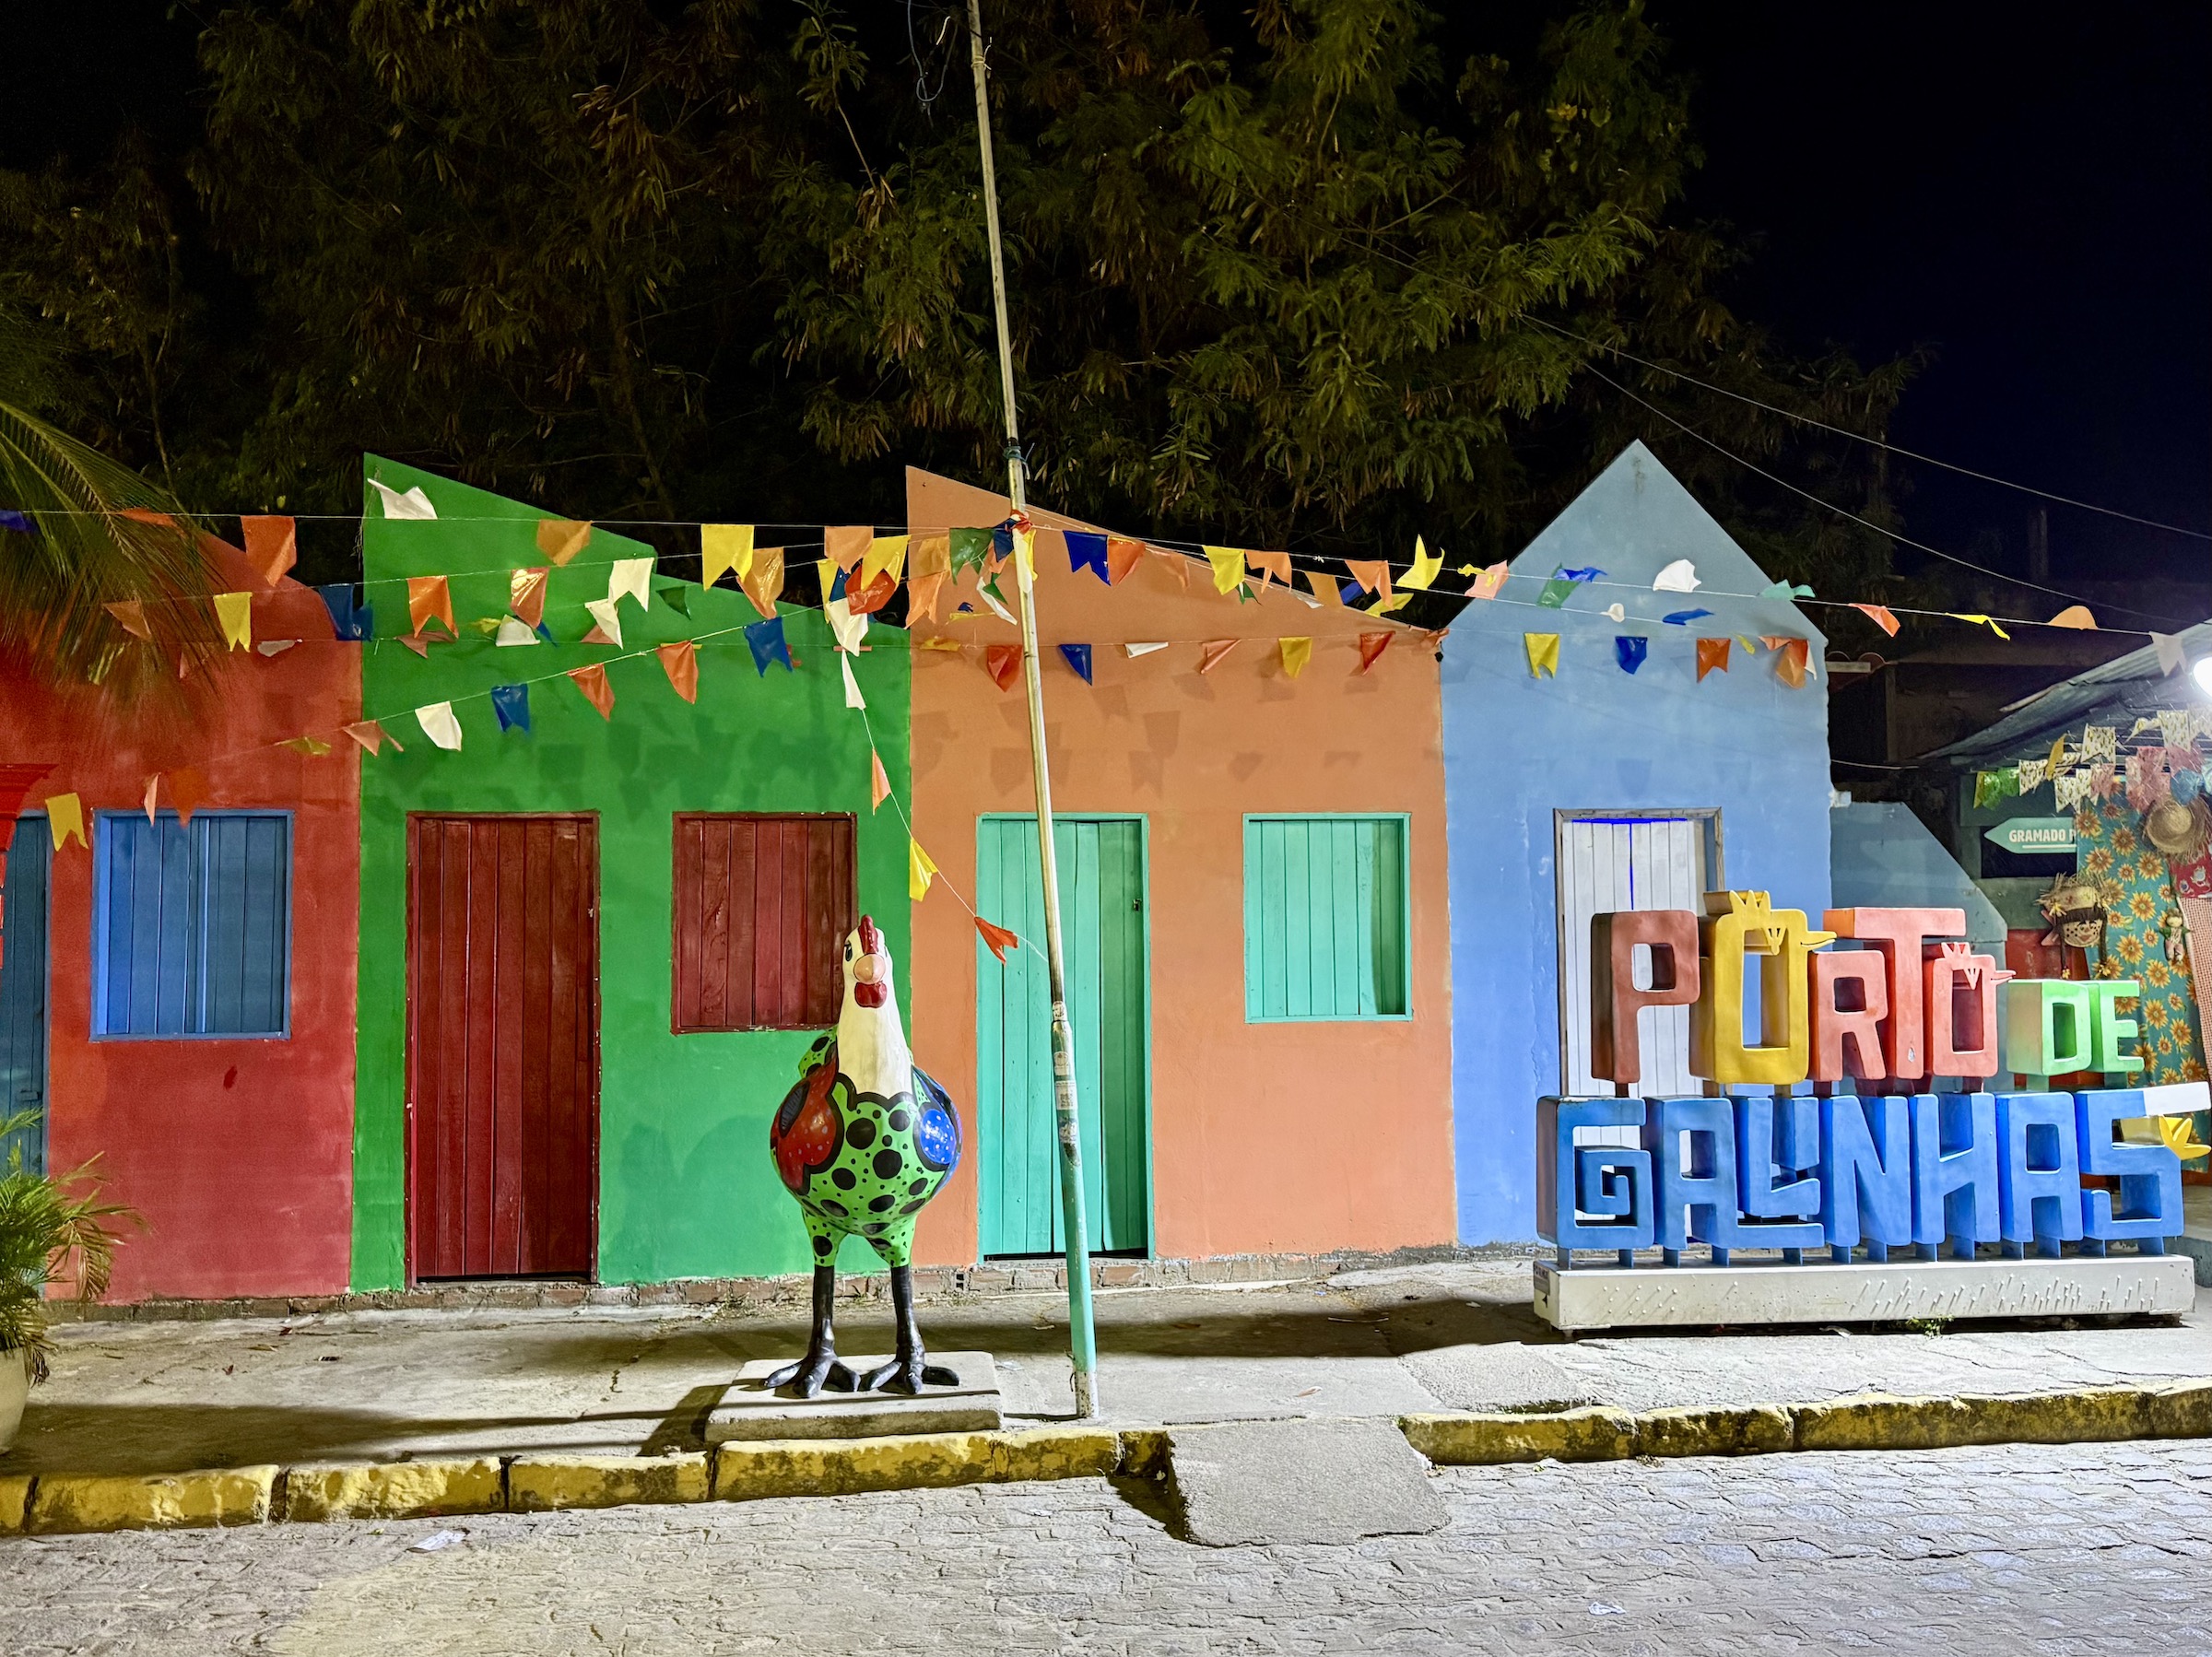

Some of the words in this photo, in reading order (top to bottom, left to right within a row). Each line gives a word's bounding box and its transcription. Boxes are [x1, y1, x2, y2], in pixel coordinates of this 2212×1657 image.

[2009, 829, 2066, 842] GRAMADO
[1592, 890, 1999, 1084] PORTO
[2007, 979, 2145, 1076] DE
[1537, 1088, 2184, 1250] GALINHAS
